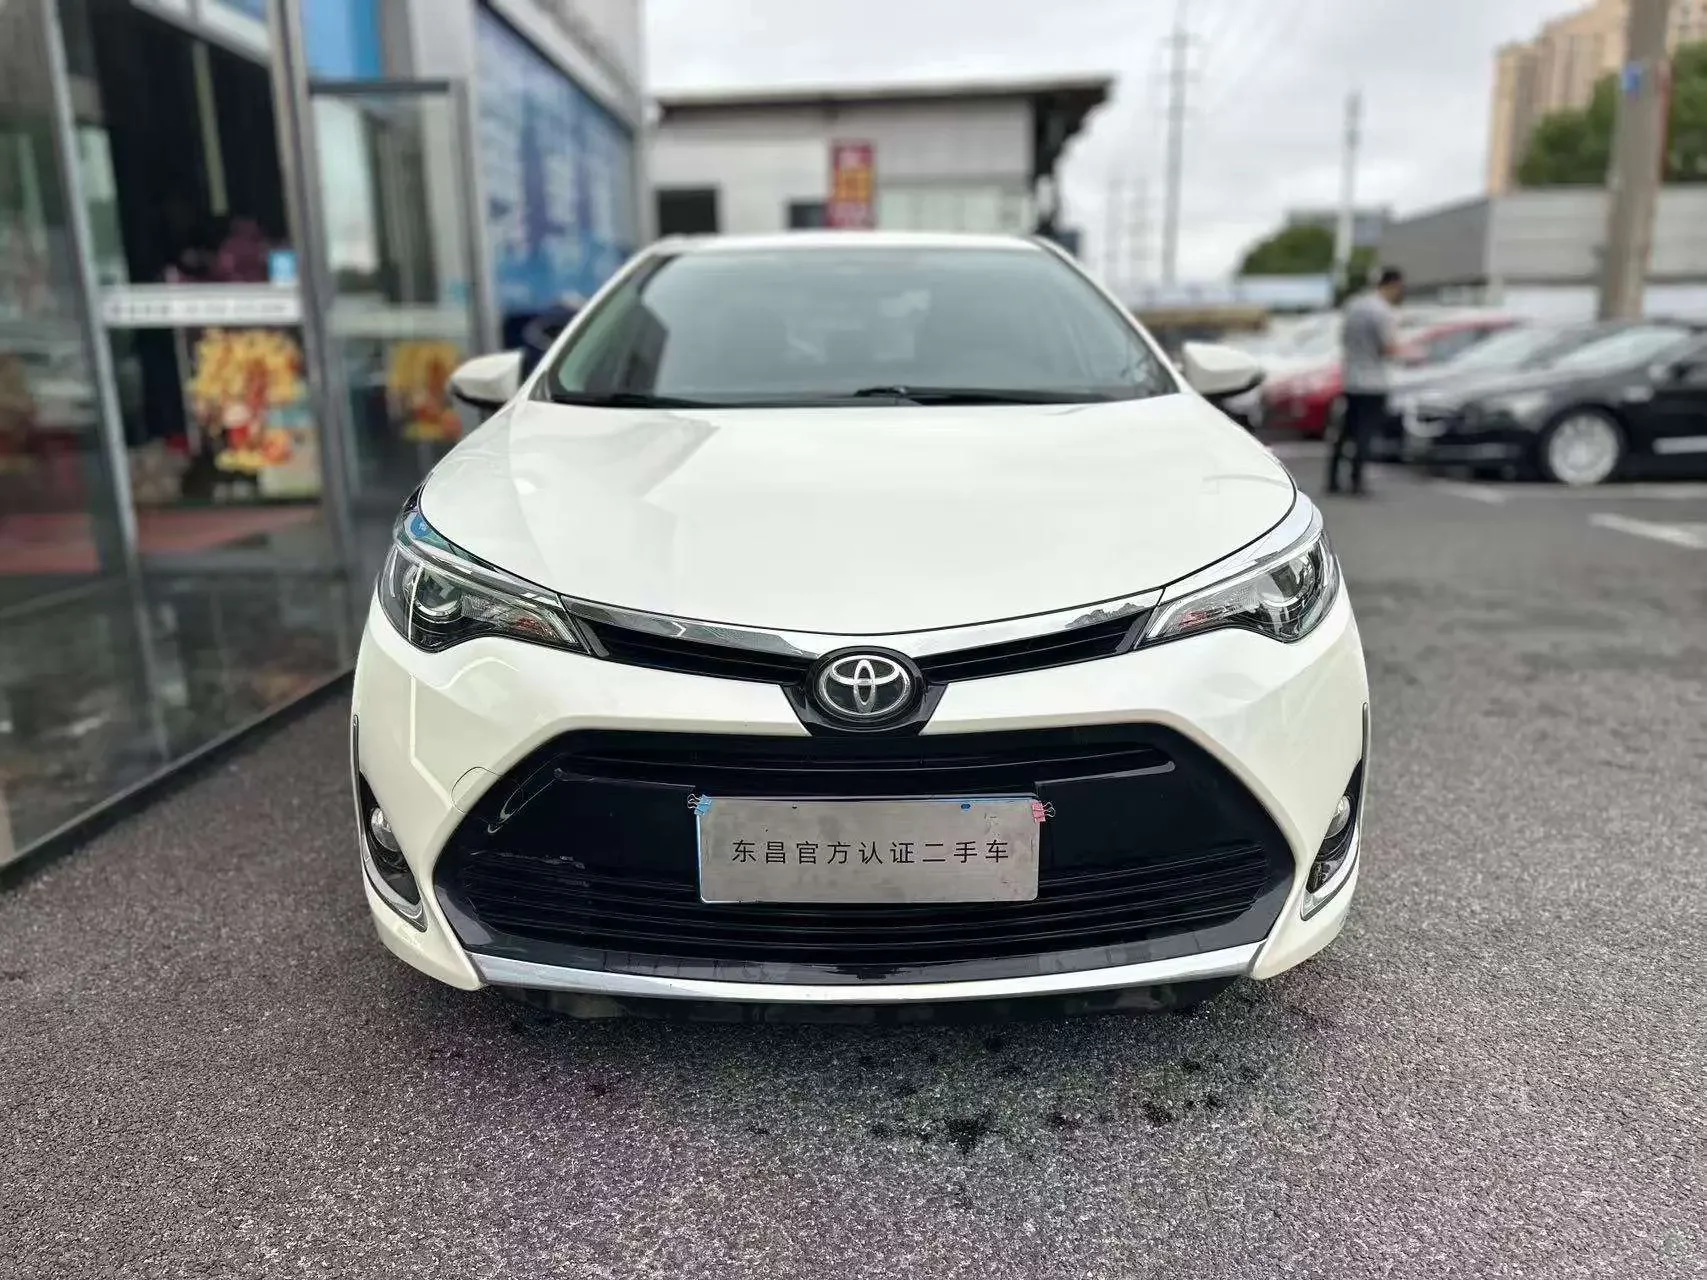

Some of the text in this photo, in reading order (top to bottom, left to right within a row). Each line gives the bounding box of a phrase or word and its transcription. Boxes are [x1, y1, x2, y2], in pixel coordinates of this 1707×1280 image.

[732, 839, 1009, 865] 东昌官方认证二手车
